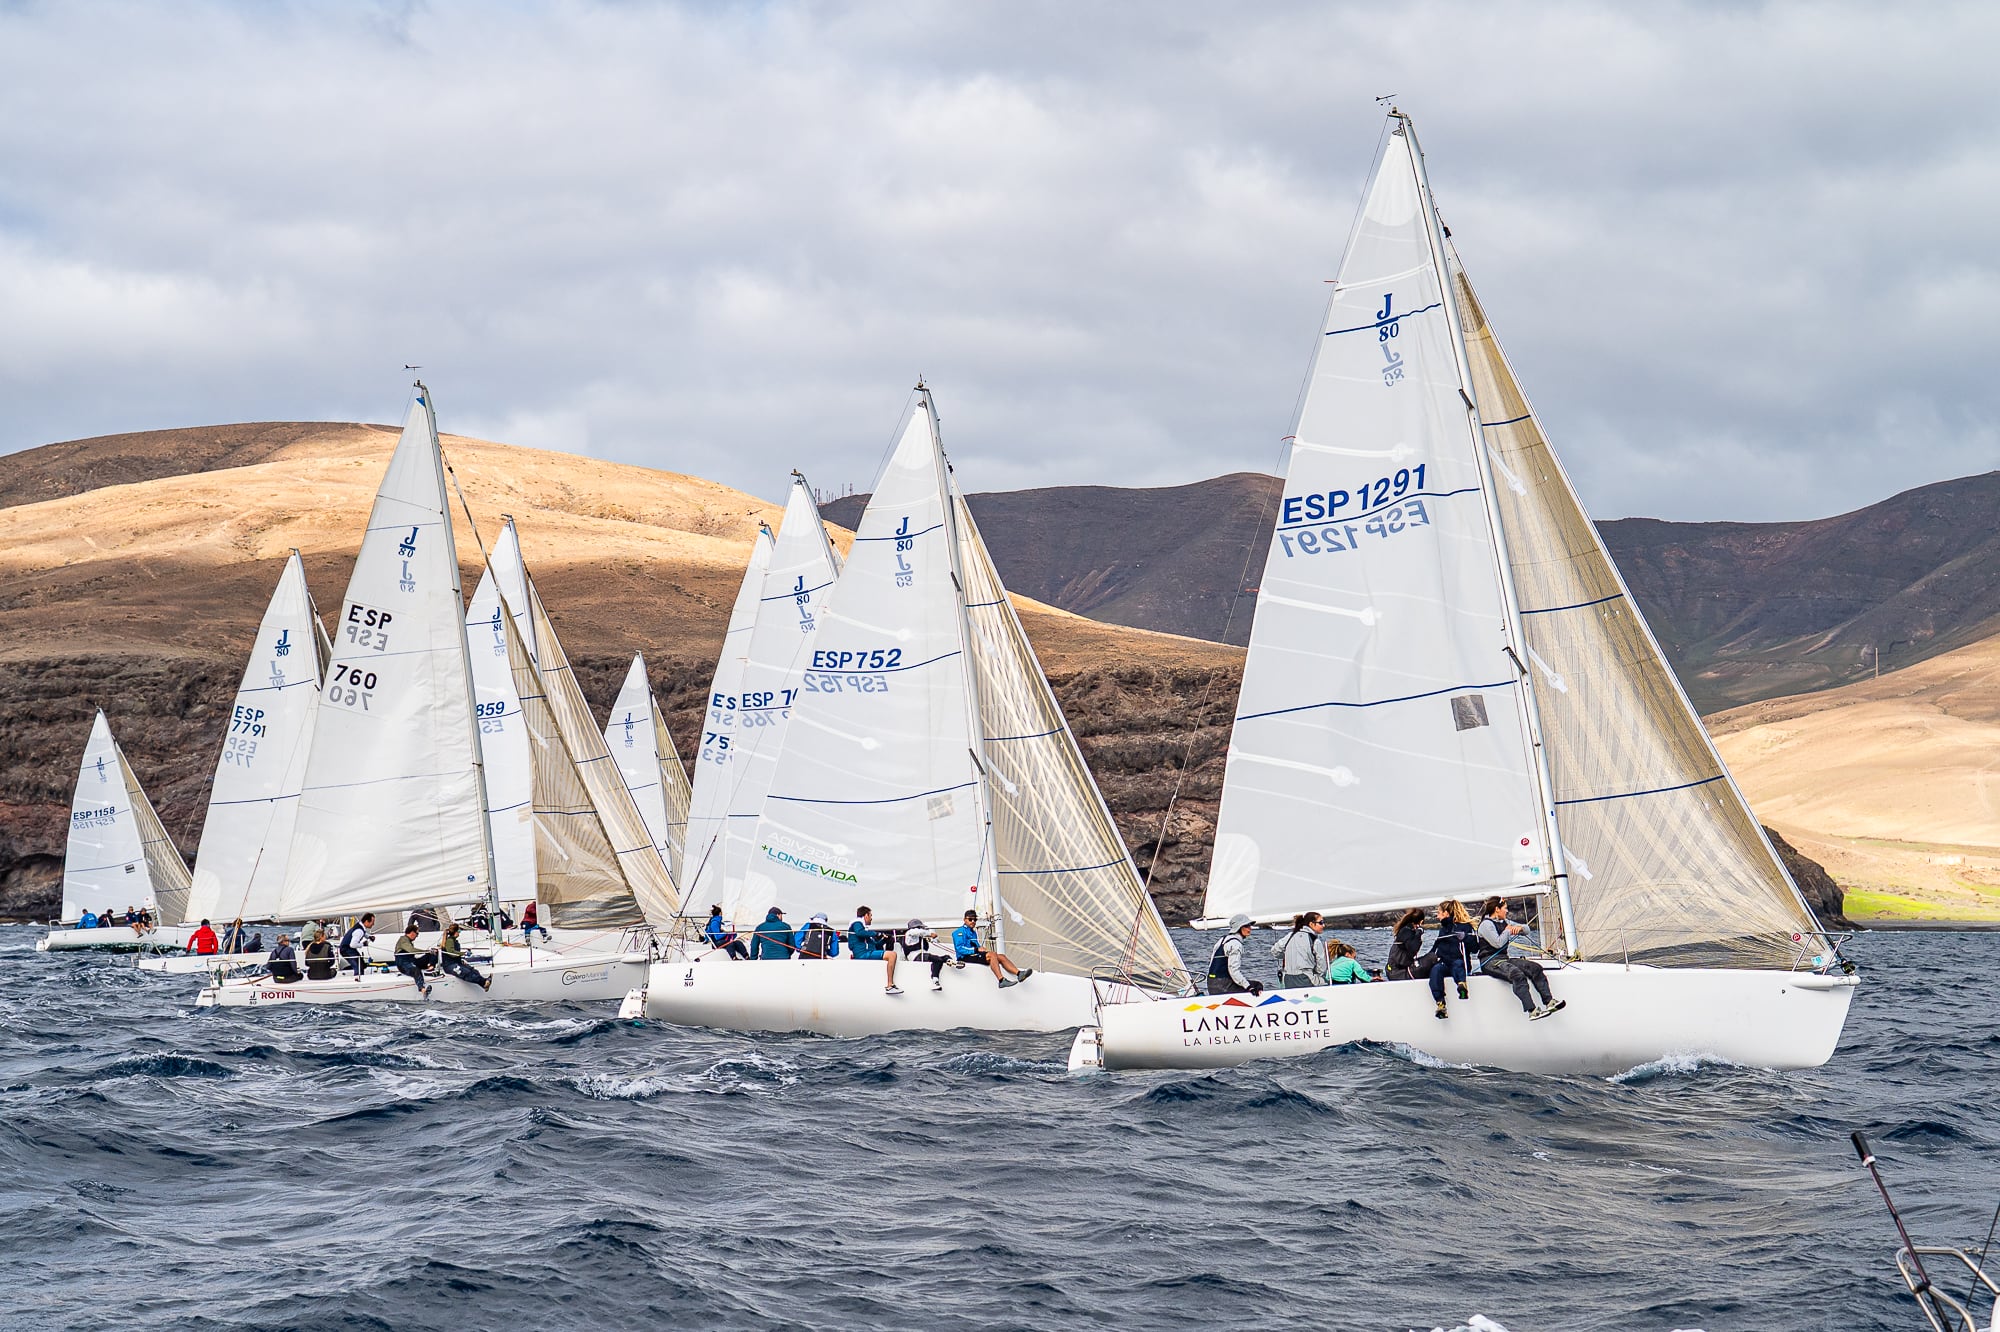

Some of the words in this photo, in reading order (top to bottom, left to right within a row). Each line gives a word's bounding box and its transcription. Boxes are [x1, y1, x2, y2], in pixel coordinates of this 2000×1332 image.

[1376, 293, 1392, 320] J
[1379, 322, 1399, 343] 80
[1283, 489, 1349, 525] ESP
[1356, 463, 1426, 511] 1291
[896, 516, 909, 535] J
[404, 526, 419, 545] J
[398, 548, 414, 558] 80
[896, 539, 913, 552] 80
[794, 575, 804, 592] J
[796, 593, 810, 606] 80
[348, 604, 393, 630] ESP
[492, 606, 501, 620] J
[277, 629, 289, 646] J
[276, 648, 289, 657] 80
[812, 650, 853, 669] ESP
[856, 648, 902, 669] 752
[333, 663, 378, 690] 760
[712, 693, 737, 710] ES
[742, 691, 774, 708] ESP
[234, 705, 265, 722] ESP
[476, 701, 505, 717] 859
[232, 719, 266, 738] 7791
[705, 731, 734, 750] 75
[73, 810, 93, 820] ESP
[94, 806, 115, 817] 1158
[685, 968, 693, 978] J
[261, 991, 295, 1000] ROTINI
[1183, 1009, 1329, 1033] LANZAROTE
[1184, 1038, 1201, 1047] LA
[1209, 1035, 1241, 1046] ISLA
[1249, 1029, 1331, 1043] DIFERENTE
